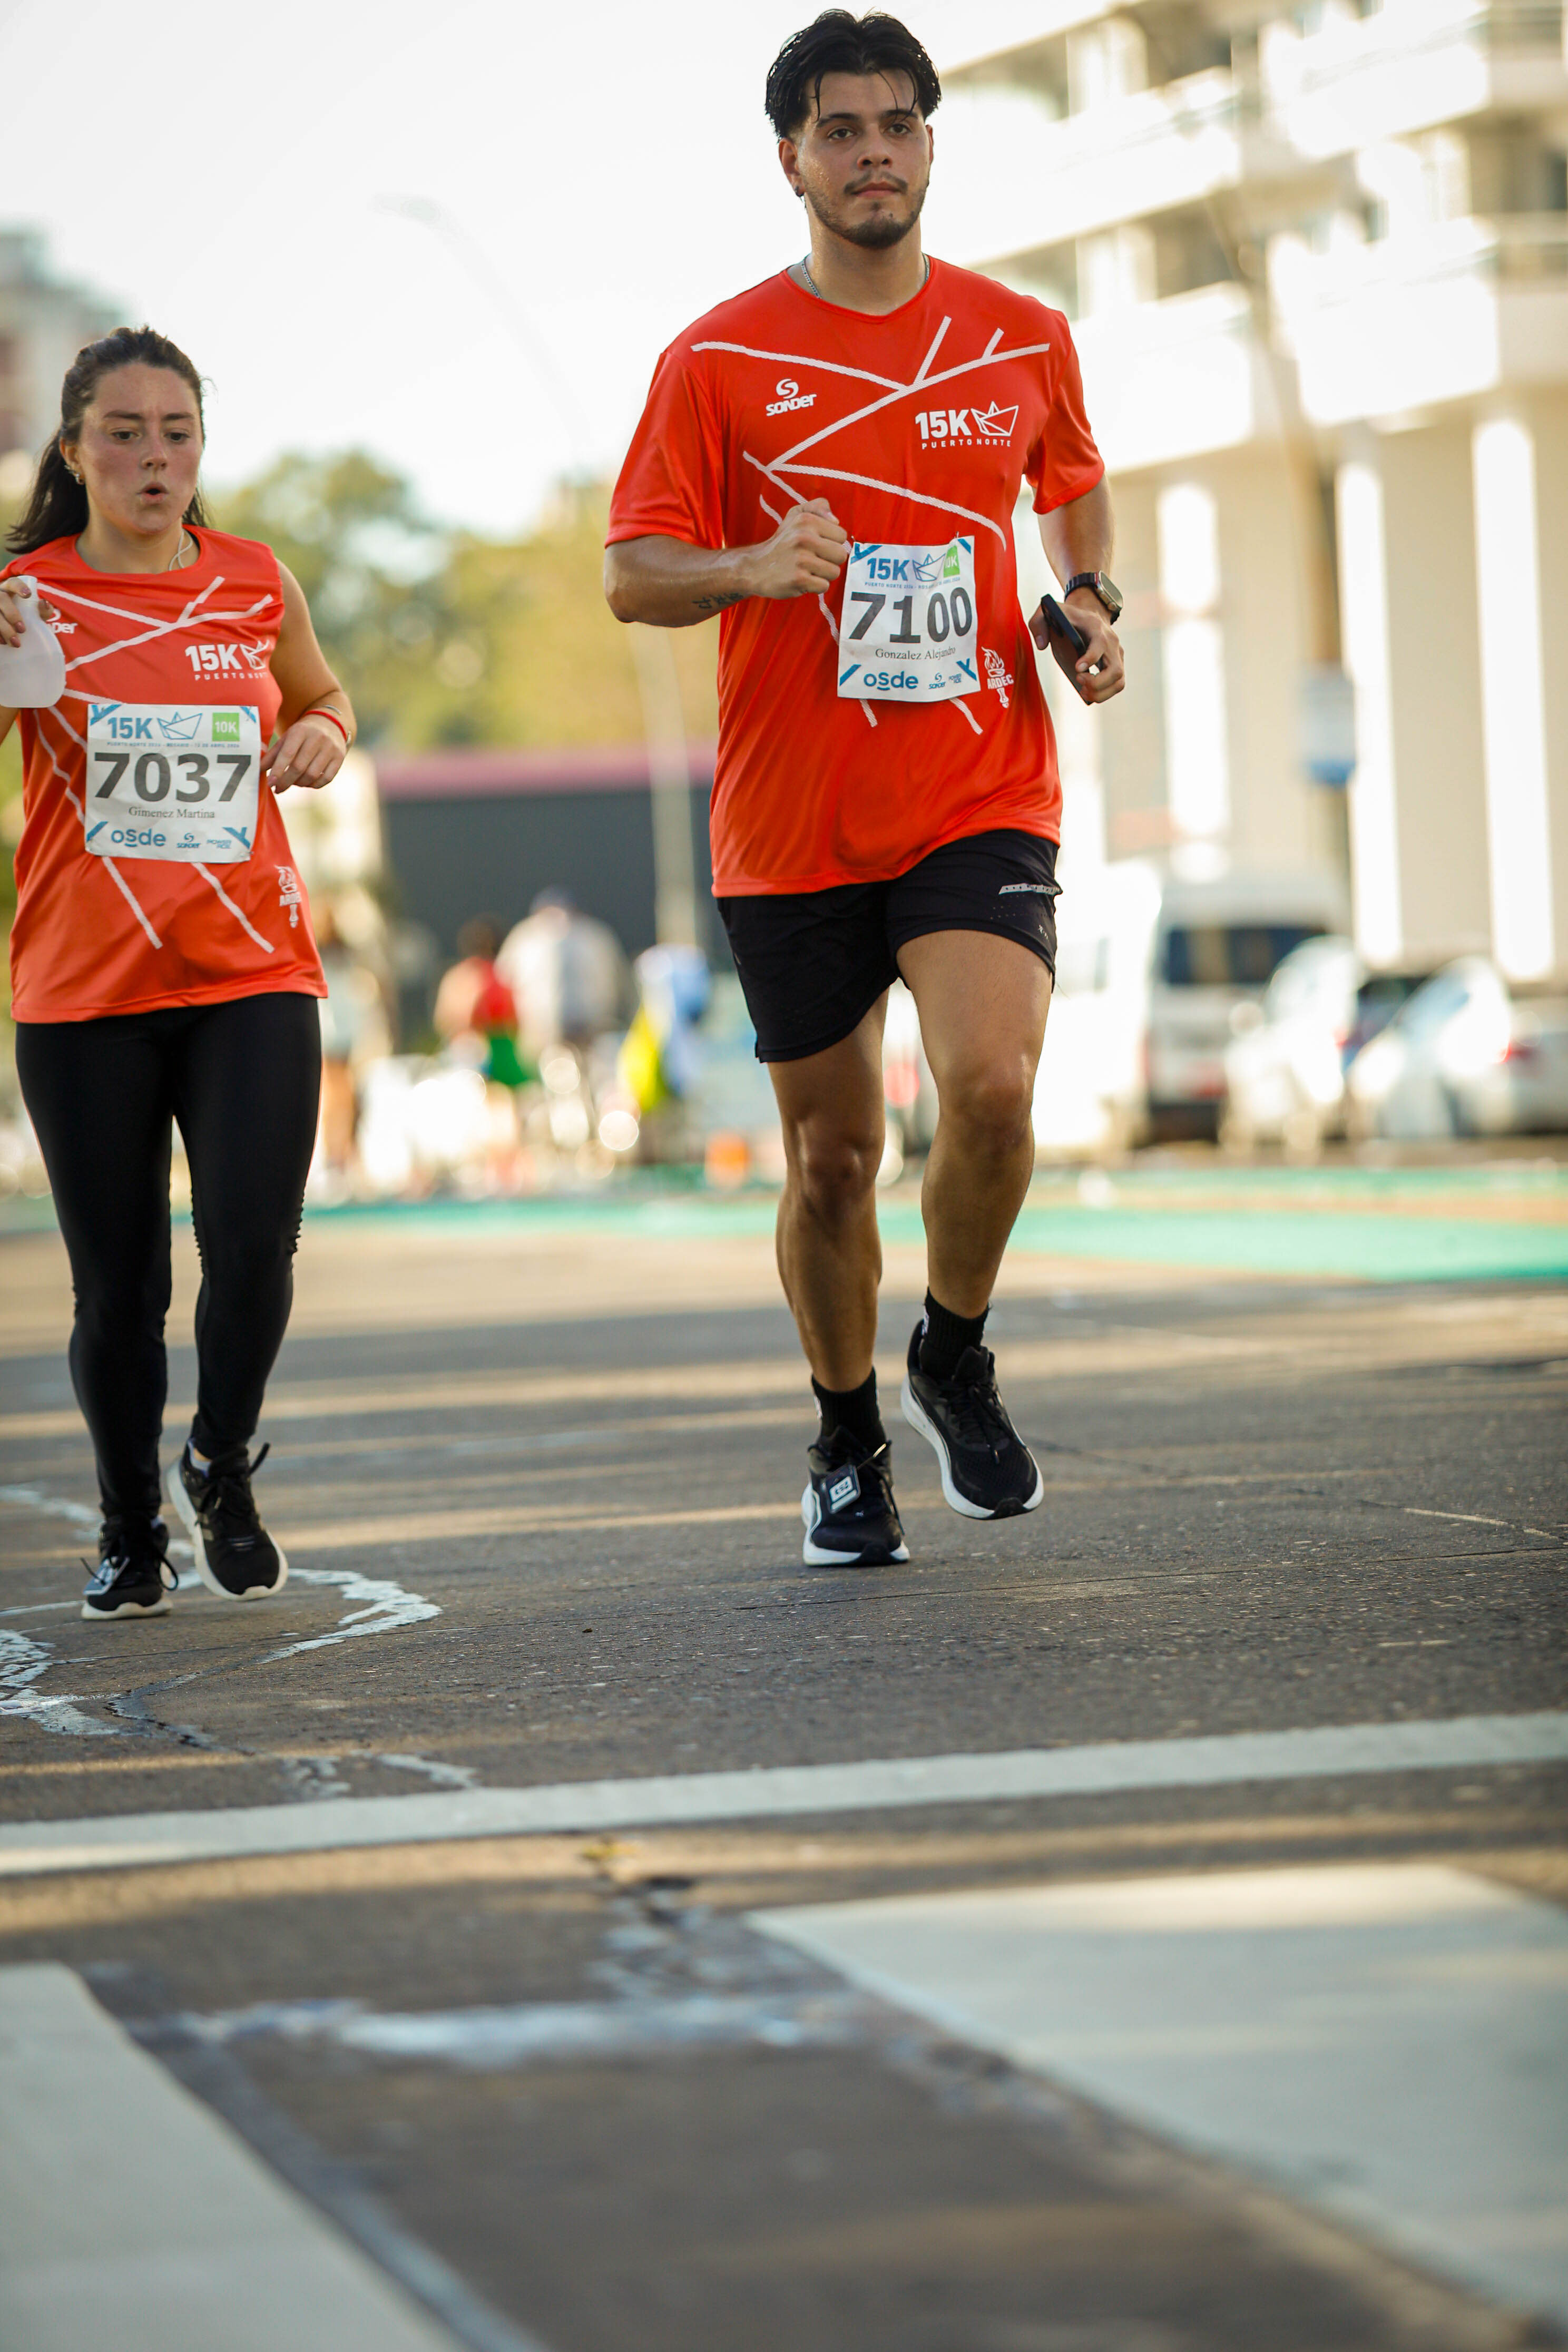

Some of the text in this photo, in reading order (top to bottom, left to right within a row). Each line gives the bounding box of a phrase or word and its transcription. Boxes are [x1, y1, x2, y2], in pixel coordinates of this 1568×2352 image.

[915, 409, 972, 439] 15K
[922, 438, 1011, 449] PUERTO NORTE
[867, 557, 910, 581] 15K
[849, 587, 972, 643] 7100
[185, 644, 242, 671] 15K
[875, 646, 956, 661] Gonzalez Alejandro
[194, 672, 244, 681] PUERTO
[864, 671, 918, 691] osde
[987, 674, 1014, 690] ARDEC
[107, 717, 153, 739] 15K
[214, 721, 237, 733] 10K
[94, 752, 251, 802] 7037
[129, 806, 215, 818] Gimenez Martina
[111, 828, 166, 847] osde
